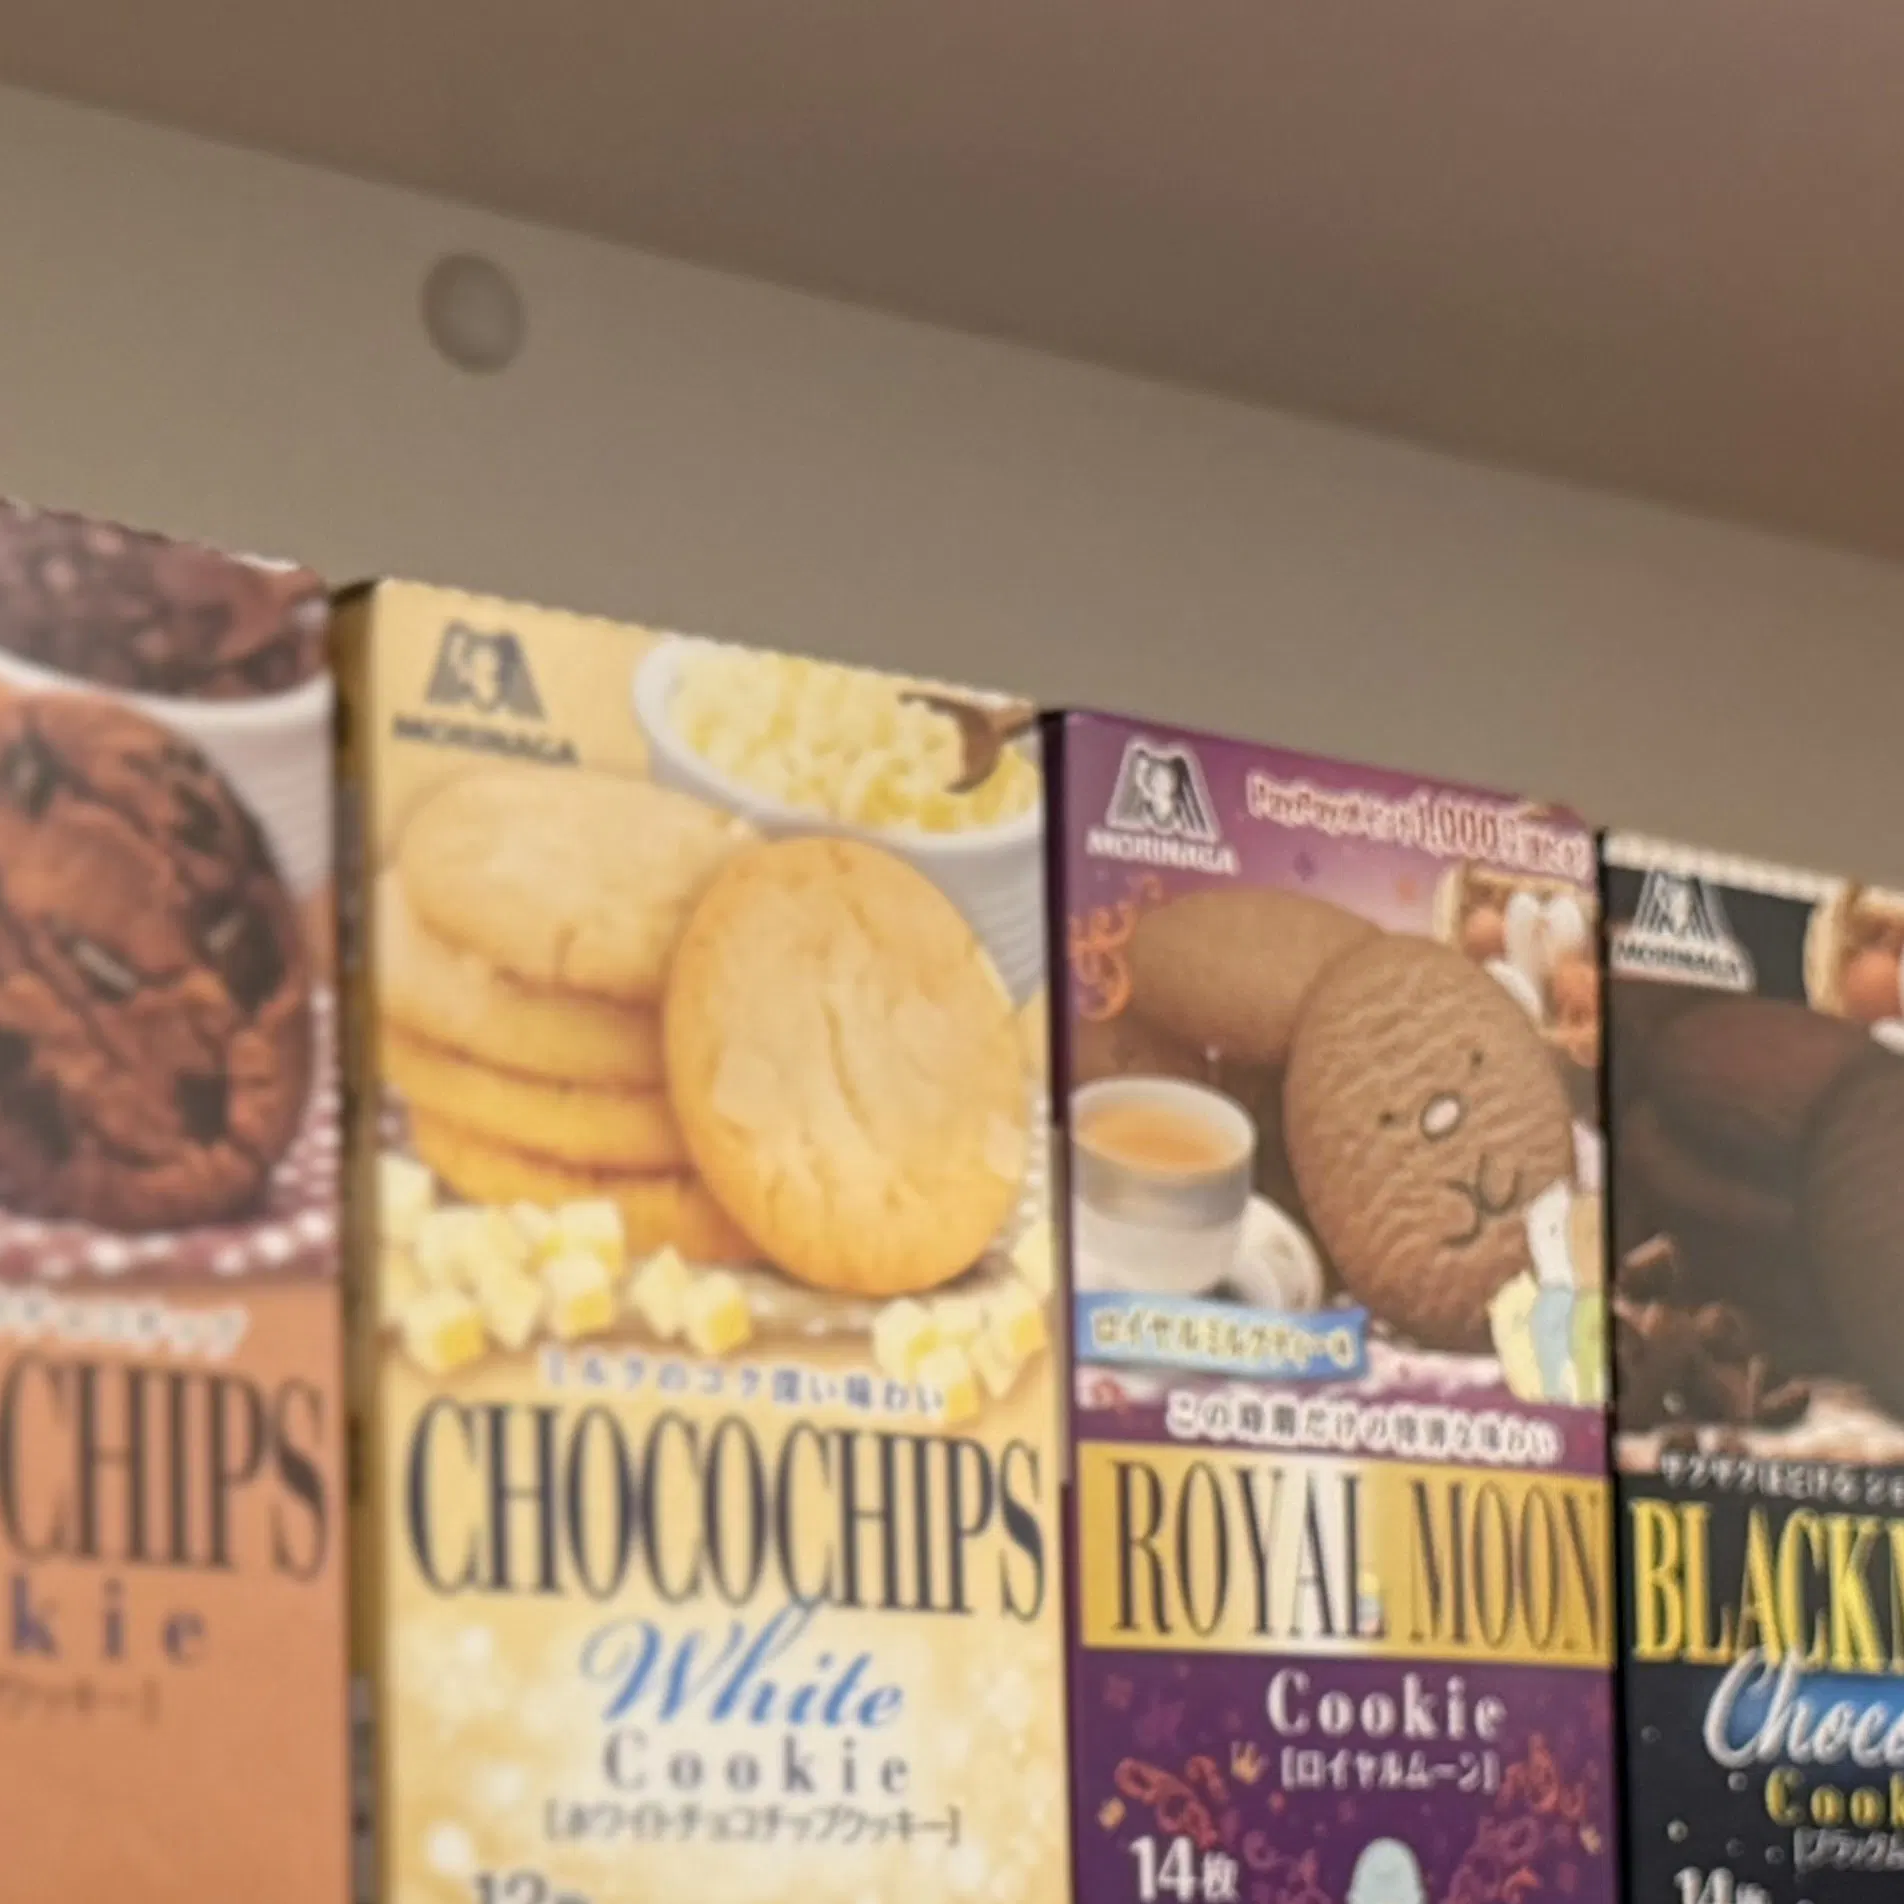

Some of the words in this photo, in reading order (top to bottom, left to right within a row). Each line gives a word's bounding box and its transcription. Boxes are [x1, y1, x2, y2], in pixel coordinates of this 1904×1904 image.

[1087, 829, 1241, 876] MORINAGA
[405, 1393, 1047, 1625] CHOCOCHIPS
[1110, 1459, 1388, 1641] ROYAL
[1408, 1476, 1613, 1654] MOON
[579, 1598, 905, 1729] White
[1267, 1669, 1507, 1739] Cookie
[604, 1730, 911, 1796] Cookie
[1129, 1836, 1240, 1901] 14枚
